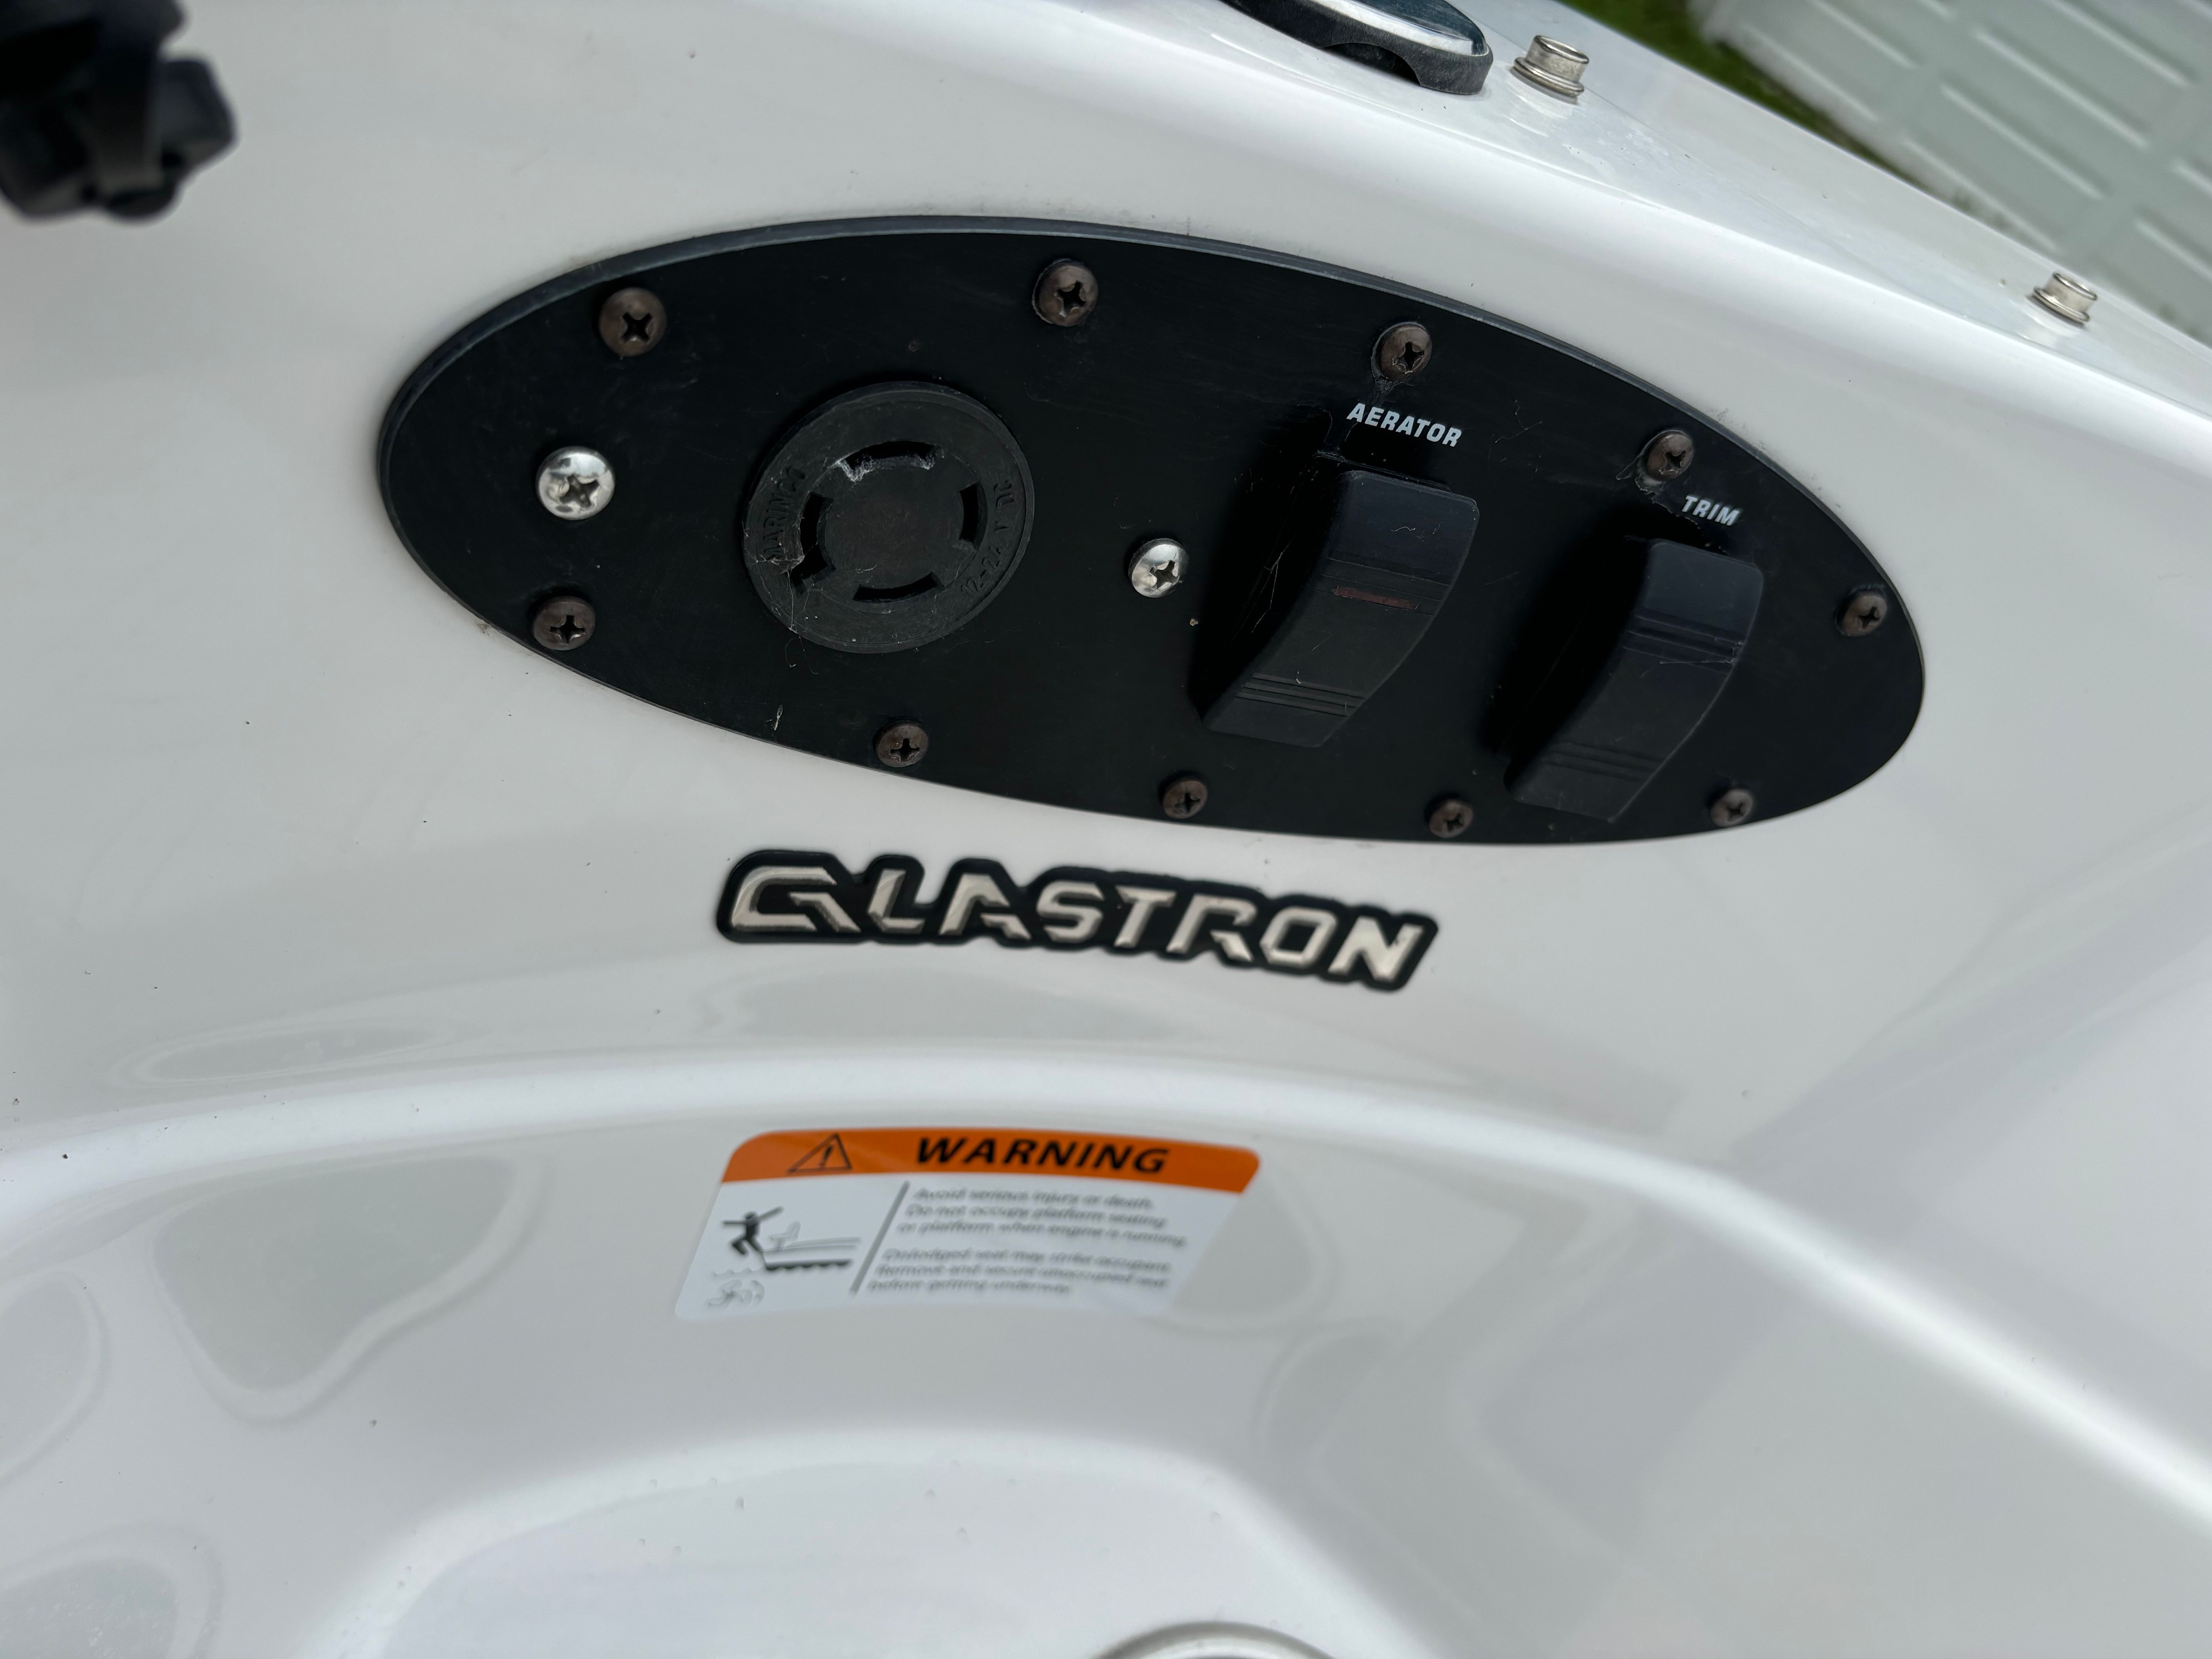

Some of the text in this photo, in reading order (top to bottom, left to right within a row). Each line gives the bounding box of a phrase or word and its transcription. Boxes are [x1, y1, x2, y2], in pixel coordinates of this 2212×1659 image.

[1346, 403, 1462, 447] AERATOR
[763, 465, 805, 562] MARINCO
[1681, 495, 1740, 526] TRIM
[730, 866, 1423, 981] GLASTRON
[917, 1137, 1168, 1172] WARNING
